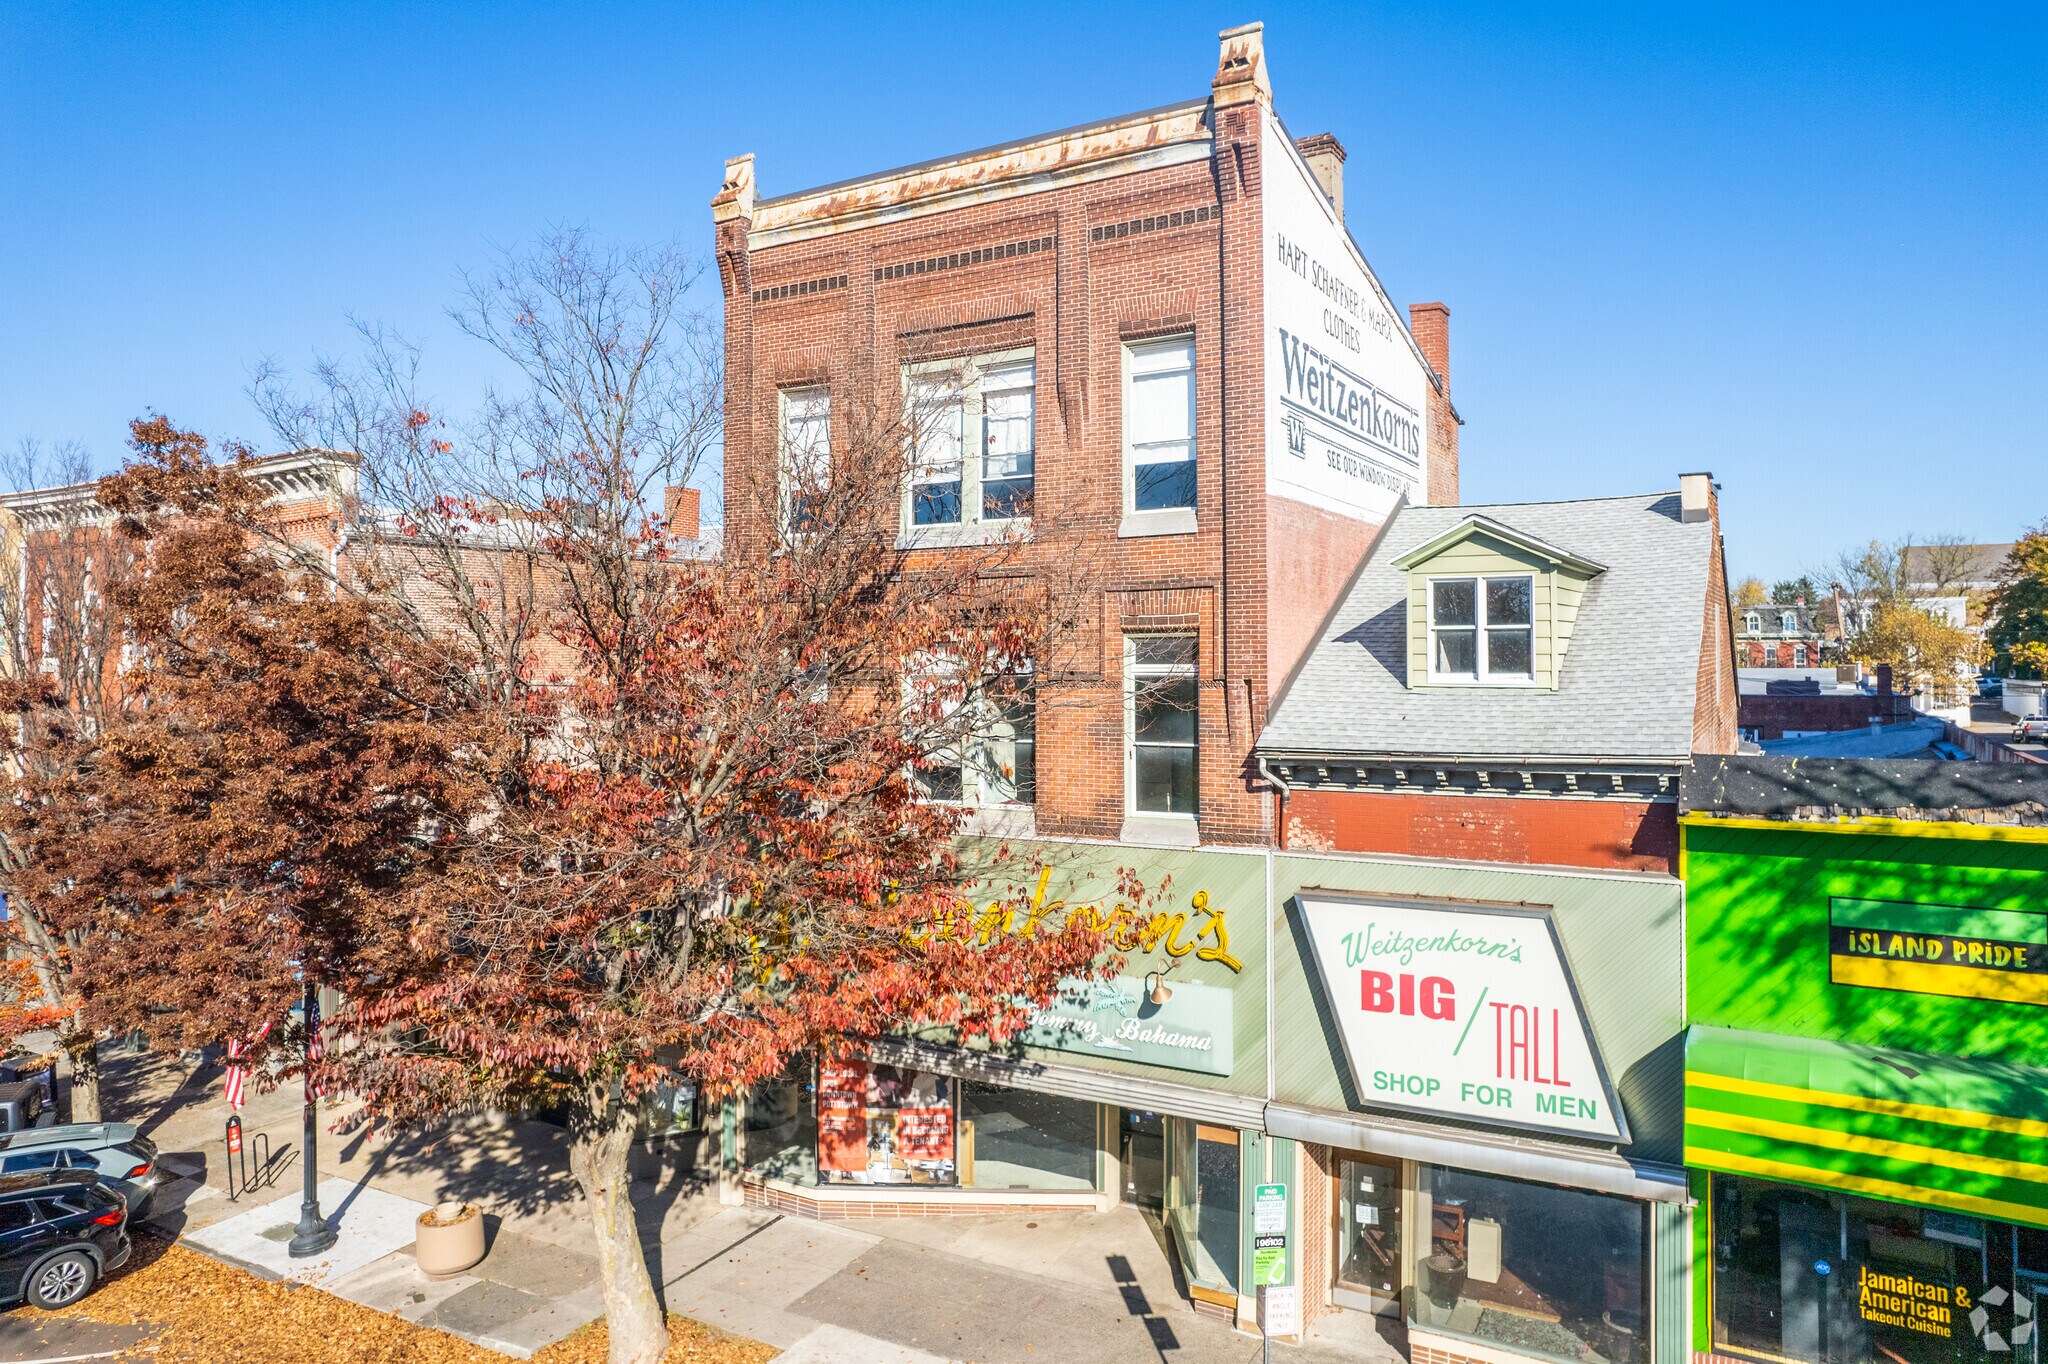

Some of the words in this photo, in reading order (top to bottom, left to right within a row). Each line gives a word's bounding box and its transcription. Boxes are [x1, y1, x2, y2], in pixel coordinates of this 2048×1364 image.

[1277, 232, 1308, 279] HART
[1311, 259, 1360, 321] SCHAFFNER
[1368, 304, 1393, 342] MARX
[1323, 308, 1361, 354] CLOTHES
[1279, 327, 1420, 459] Weitzenkorns
[1327, 449, 1341, 471] SEE
[1343, 456, 1358, 477] OUR
[1341, 922, 1522, 968] Weitzenkorn's
[1026, 1003, 1100, 1043] Tommy
[1115, 1016, 1213, 1051] Bahama
[1361, 969, 1456, 1021] BIG
[1489, 1001, 1571, 1087] TALL
[1373, 1070, 1441, 1097] SHOP
[1461, 1082, 1512, 1109] FOR
[1536, 1093, 1597, 1121] MEN
[902, 1115, 946, 1124] INTERESTED
[903, 1126, 911, 1135] IN
[912, 1126, 949, 1135] BECOMING
[903, 1137, 909, 1145] A
[1859, 1266, 1948, 1303] Jamaican
[1955, 1286, 1971, 1308] &
[1860, 1285, 1951, 1323] American
[1860, 1305, 1905, 1327] Takeout
[1907, 1316, 1951, 1337] Cuisine
